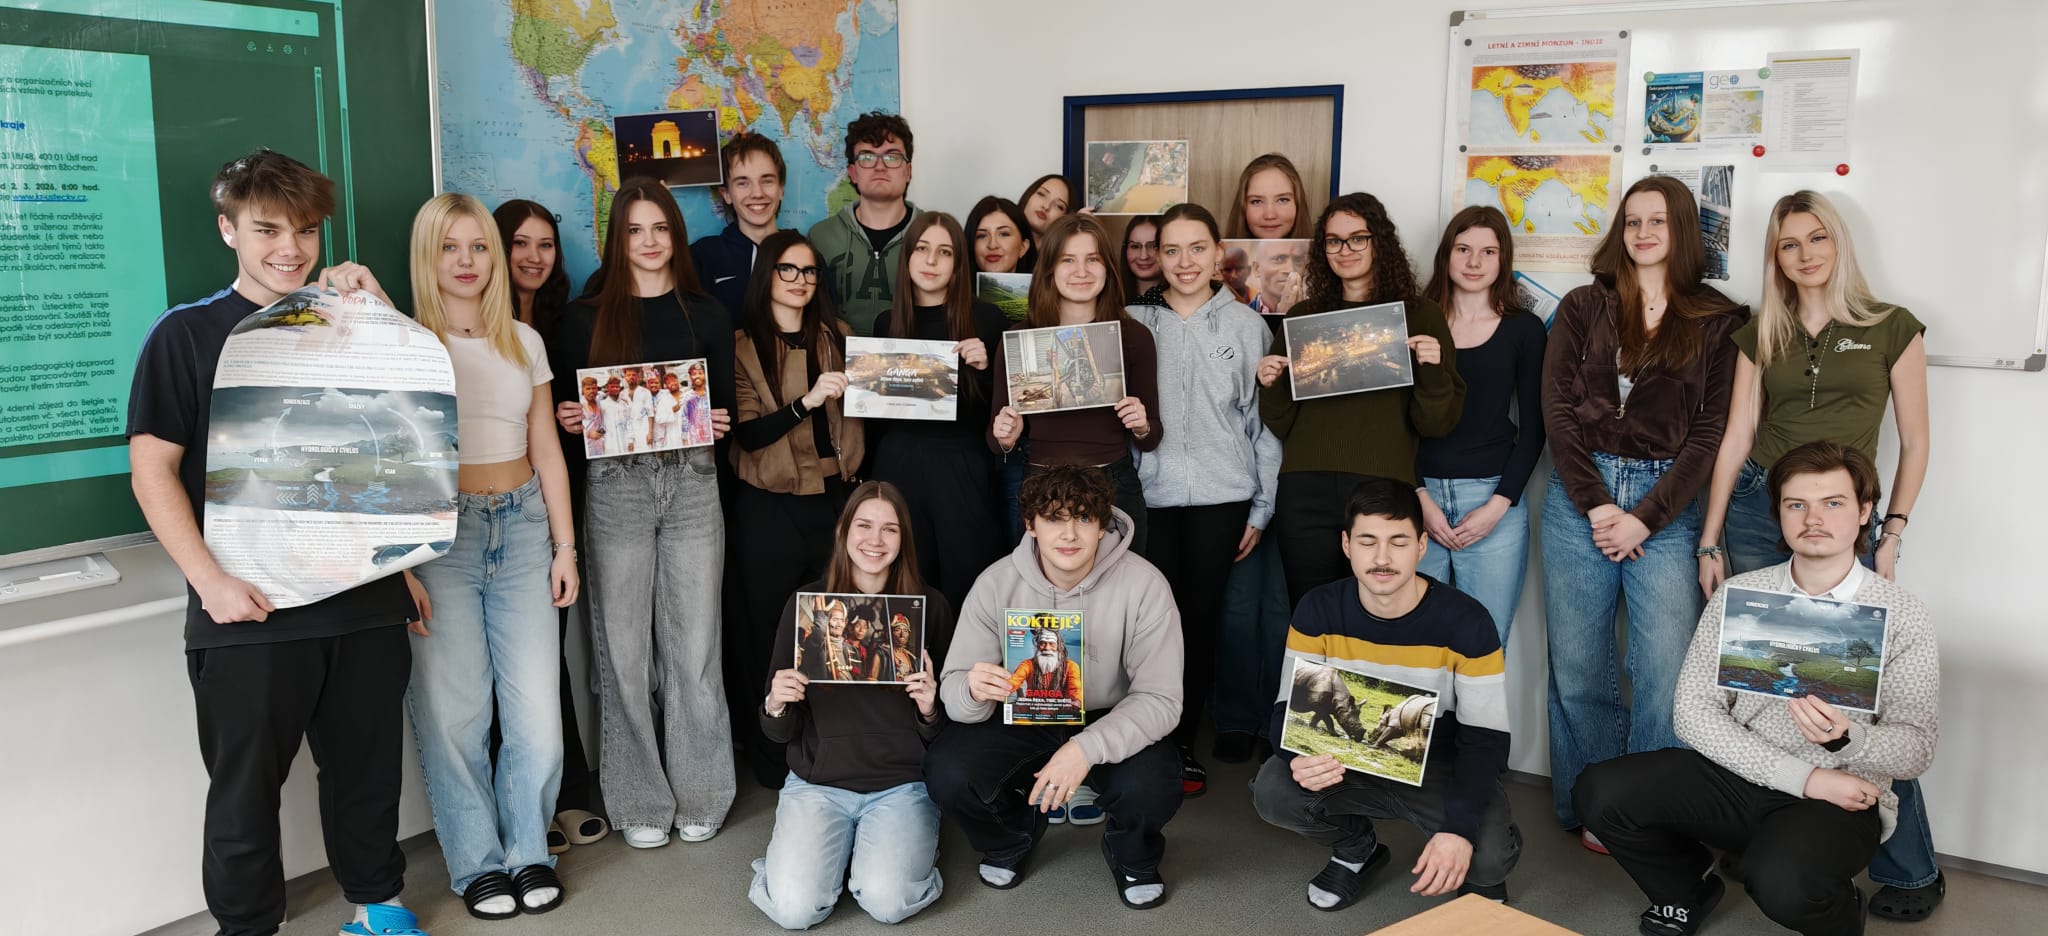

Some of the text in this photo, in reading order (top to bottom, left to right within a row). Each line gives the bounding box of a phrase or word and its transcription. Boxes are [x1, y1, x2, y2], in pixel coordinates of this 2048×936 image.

[1487, 41, 1508, 50] LETNÍ
[1518, 40, 1540, 48] ZIMNÍ
[1542, 39, 1574, 47] MONZUN
[55, 89, 92, 98] protokolu
[66, 152, 80, 161] Ústí
[82, 154, 98, 162] nad
[10, 162, 57, 170] Jaroslavem
[36, 183, 57, 192] 2026,
[30, 212, 54, 220] řádně
[56, 212, 102, 222] navštěvující
[34, 223, 68, 231] sníženou
[72, 222, 103, 230] známku
[57, 232, 79, 240] dívek
[33, 242, 60, 250] složení
[62, 242, 82, 252] týmů
[84, 242, 105, 250] takto
[34, 252, 65, 260] důvodů
[24, 263, 58, 272] školách,
[74, 292, 109, 300] otázkami
[42, 302, 84, 310] Ústeckého
[90, 302, 110, 310] kraje
[92, 311, 110, 319] vždy
[44, 320, 90, 330] odeslaných
[92, 319, 112, 328] kvízů
[14, 334, 36, 342] může
[38, 332, 52, 341] být
[54, 331, 86, 340] součástí
[88, 330, 112, 339] pouze
[20, 360, 74, 372] pedagogický
[76, 358, 114, 368] doprovod
[30, 372, 88, 382] zpracovávány
[90, 369, 115, 378] pouze
[886, 368, 918, 378] GANGA
[31, 381, 54, 390] třetím
[56, 380, 90, 389] stranám.
[7, 402, 36, 412] 4denní
[38, 401, 64, 412] zájezd
[81, 398, 104, 408] Belgie
[56, 408, 80, 418] všech
[15, 422, 49, 432] cestovní
[89, 416, 119, 424] Veškeré
[89, 426, 109, 434] která
[112, 426, 120, 434] je
[1007, 615, 1074, 630] KOKTEJL
[1025, 690, 1062, 698] GANGA
